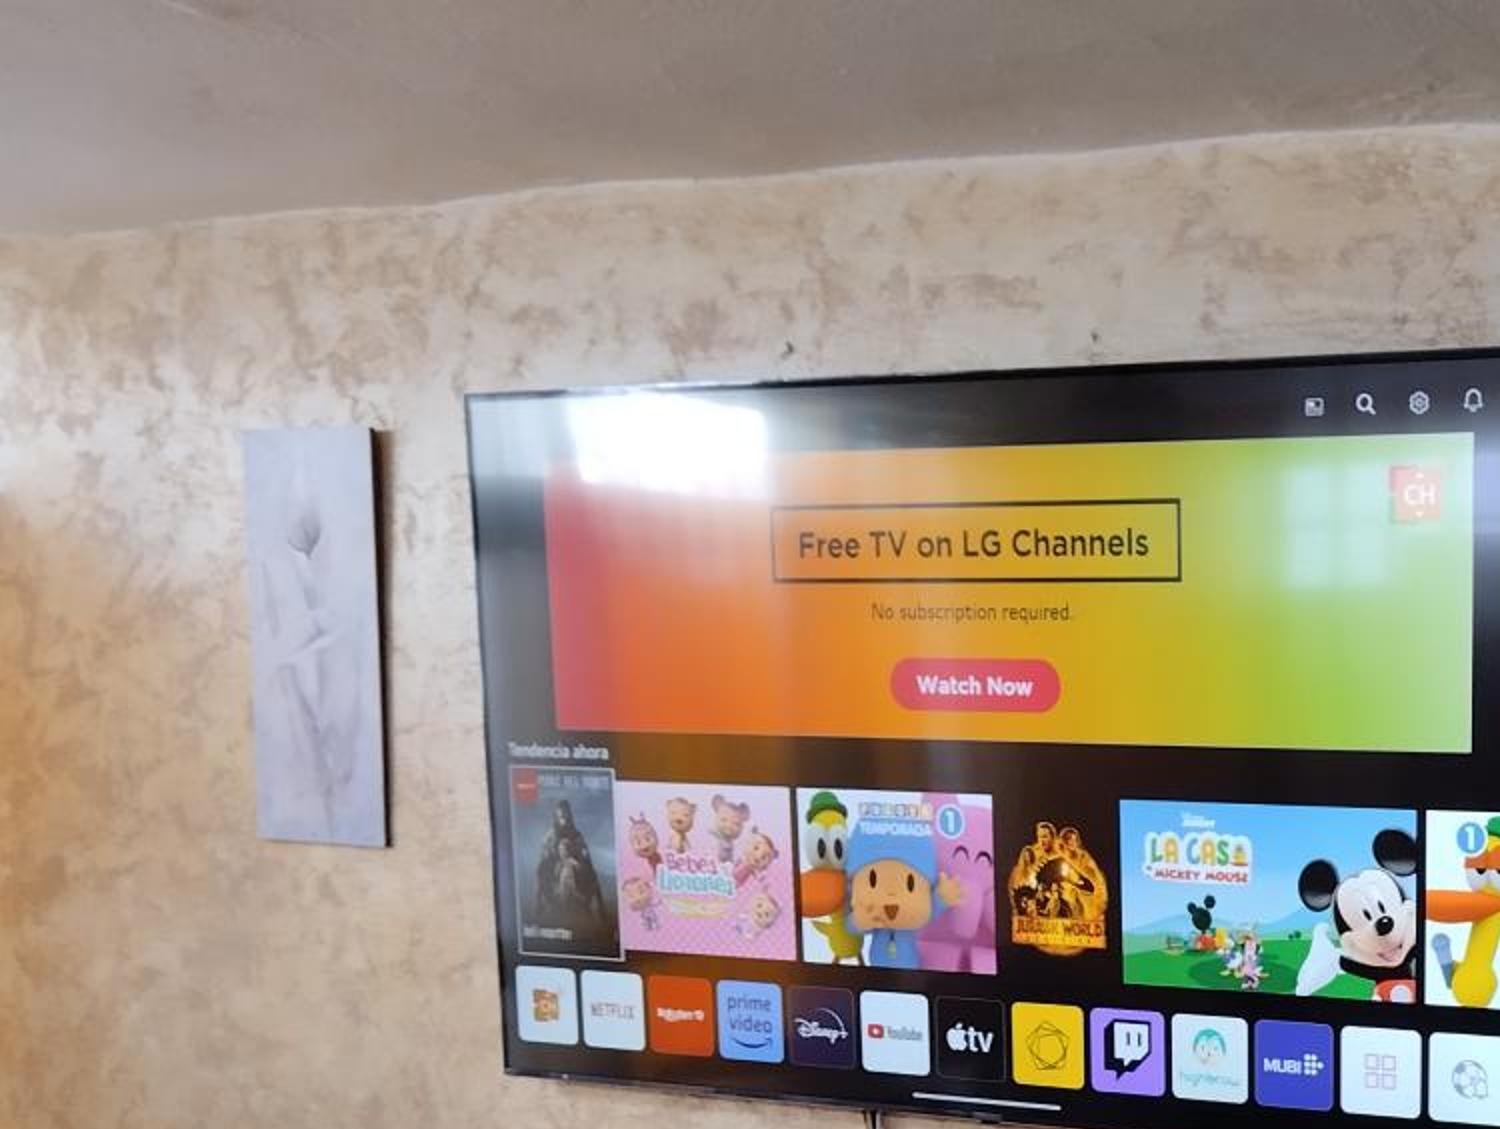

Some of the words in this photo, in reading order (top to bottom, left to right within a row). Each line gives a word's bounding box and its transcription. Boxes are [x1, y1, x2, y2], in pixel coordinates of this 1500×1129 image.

[1404, 483, 1436, 505] CH
[799, 531, 861, 560] Free
[869, 530, 907, 558] TV
[917, 534, 952, 558] on
[963, 529, 1001, 556] LG
[1012, 527, 1149, 557] Channels
[870, 602, 895, 620] No
[899, 602, 997, 624] subscription
[916, 674, 981, 696] Watch
[987, 675, 1034, 698] Now
[508, 741, 570, 759] Tendencia
[573, 743, 609, 760] ahora
[1150, 837, 1179, 864] LA
[1154, 867, 1200, 881] MICKEY
[1205, 870, 1249, 883] MOUSE
[1063, 921, 1103, 938] WORLD
[591, 1002, 635, 1020] NETFLIX
[727, 995, 771, 1012] prime
[729, 1014, 773, 1033] video
[885, 1025, 923, 1041] YouTube
[968, 1026, 994, 1052] tv
[1263, 1057, 1303, 1075] MUBI
